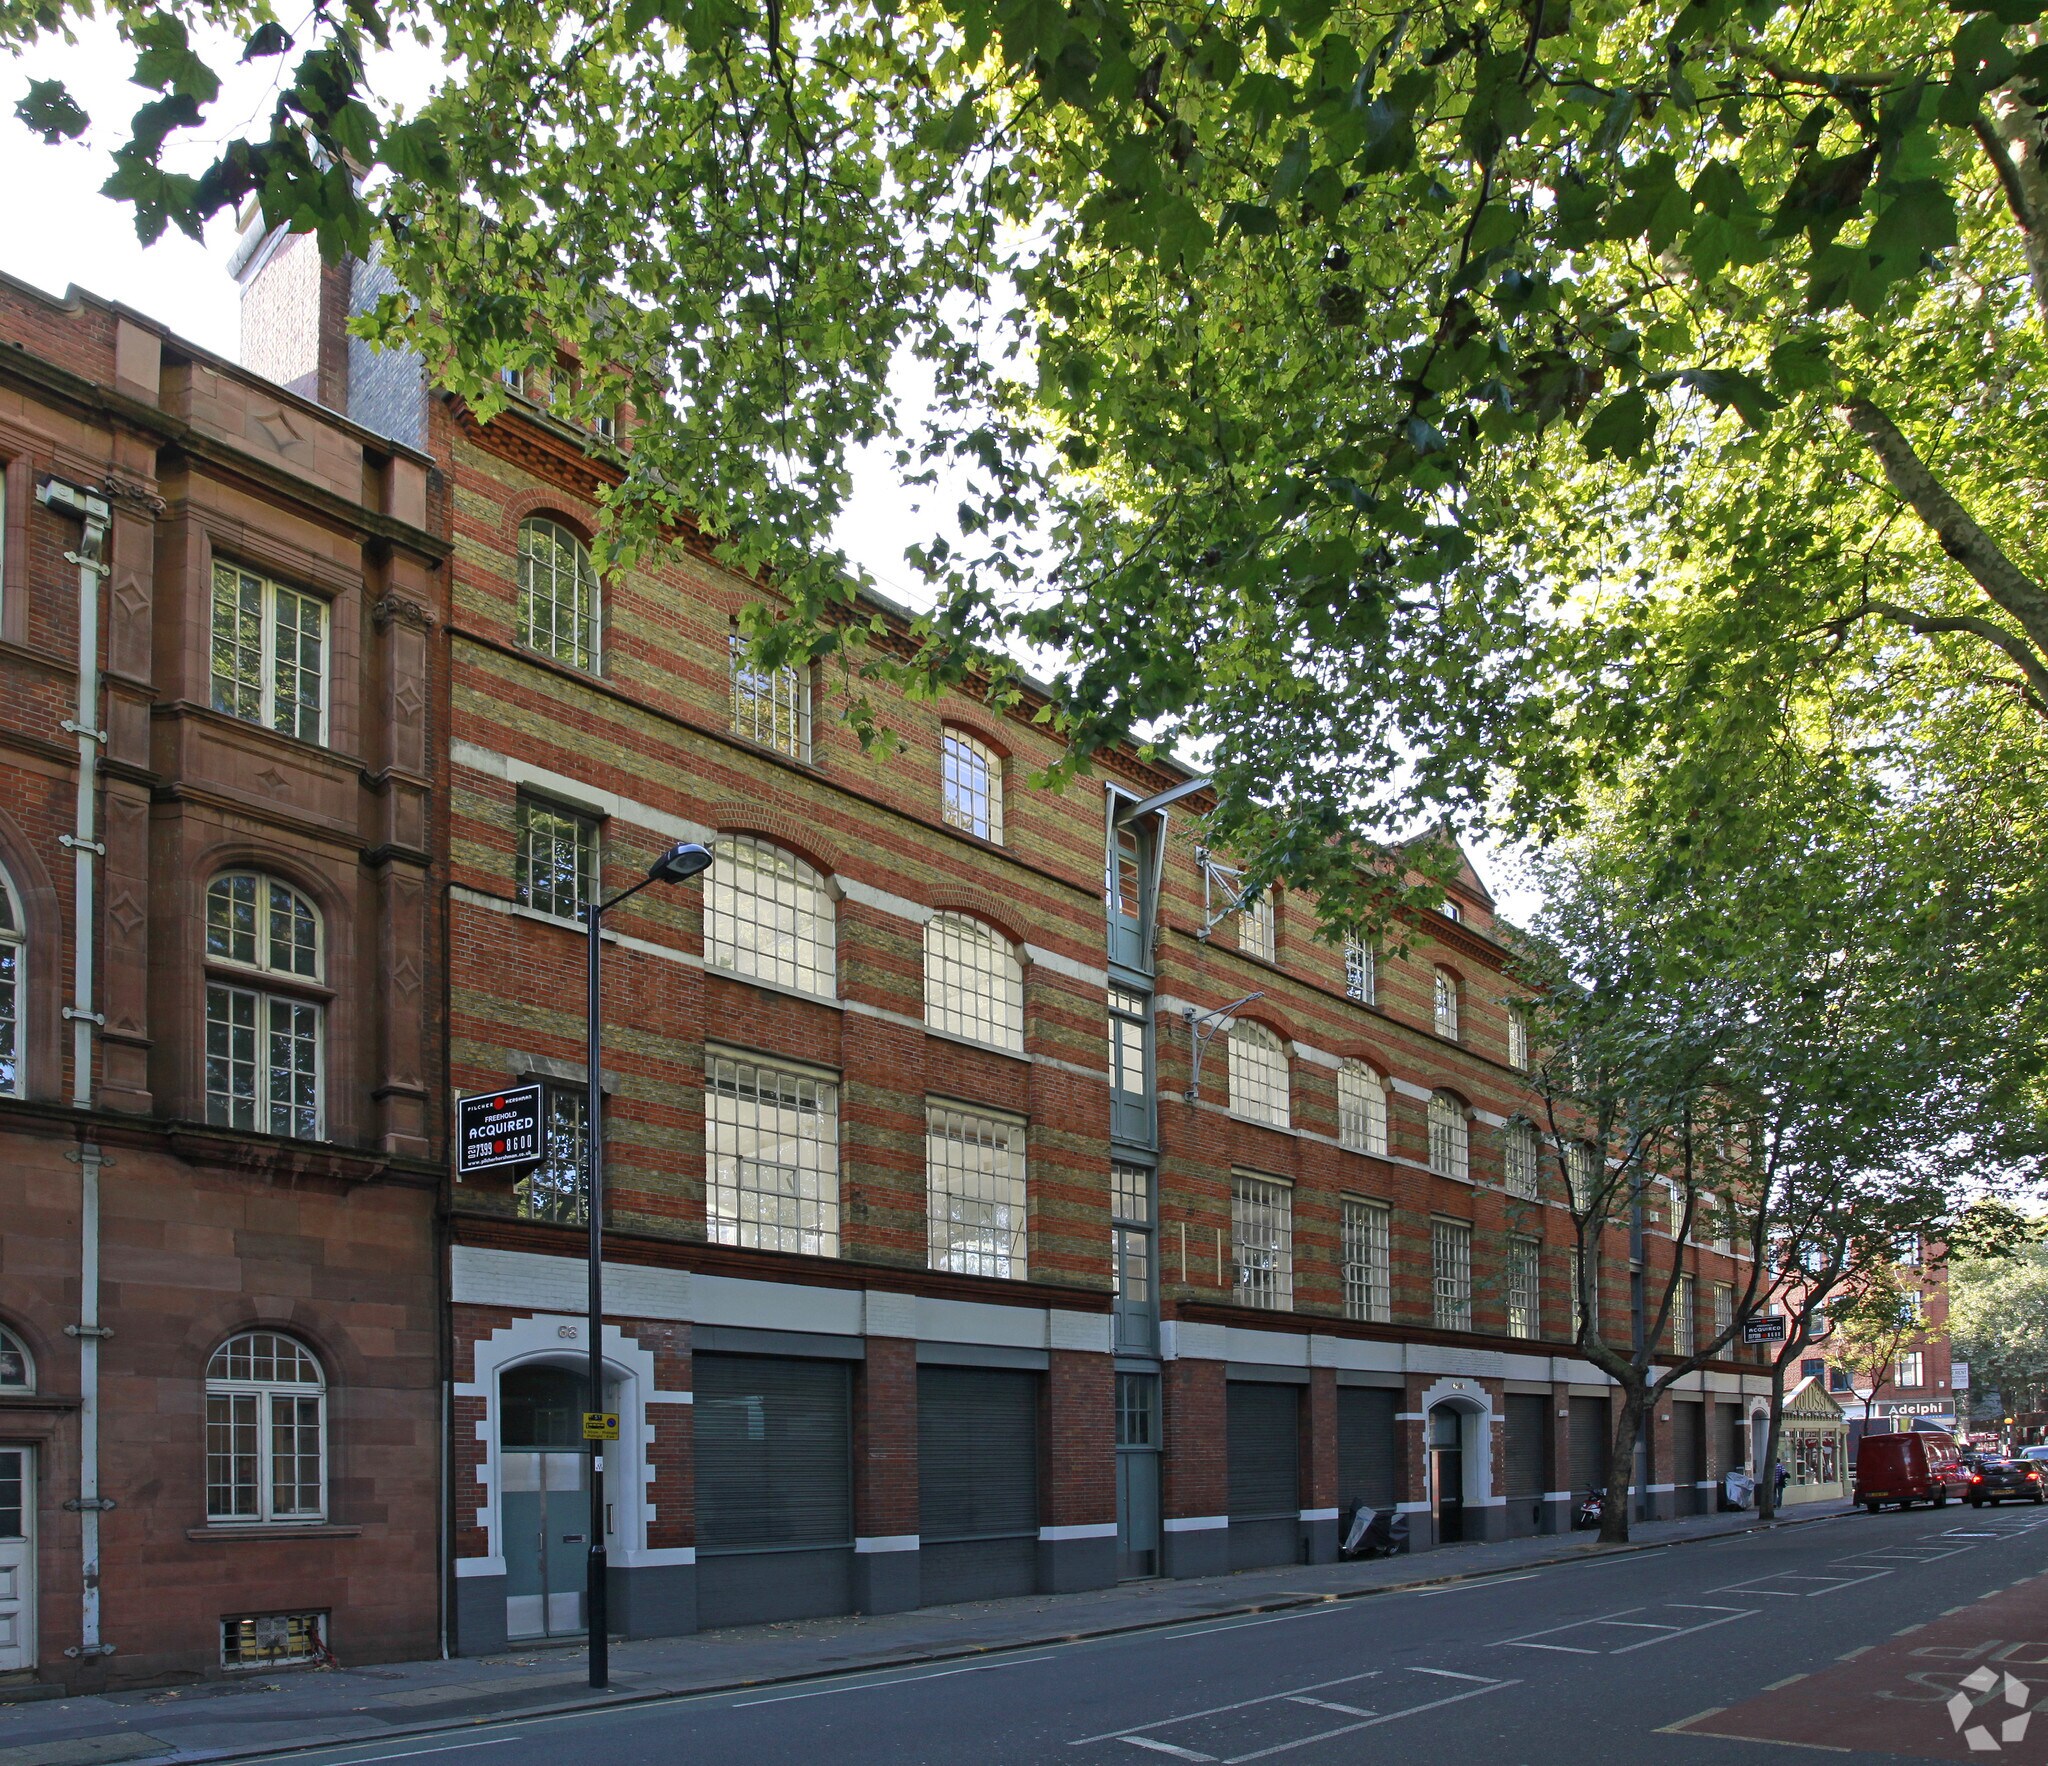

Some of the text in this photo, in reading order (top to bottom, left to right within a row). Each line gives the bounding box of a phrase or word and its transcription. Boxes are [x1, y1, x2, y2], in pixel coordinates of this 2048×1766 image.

[468, 1103, 493, 1111] PILCHER
[484, 1111, 517, 1123] FREEHOLD
[469, 1117, 533, 1139] ACQUIRED
[467, 1134, 532, 1159] 020 7399 8600
[467, 1150, 532, 1166] www.pilcherhershman.co.uk
[1888, 1402, 1943, 1415] Adelphi
